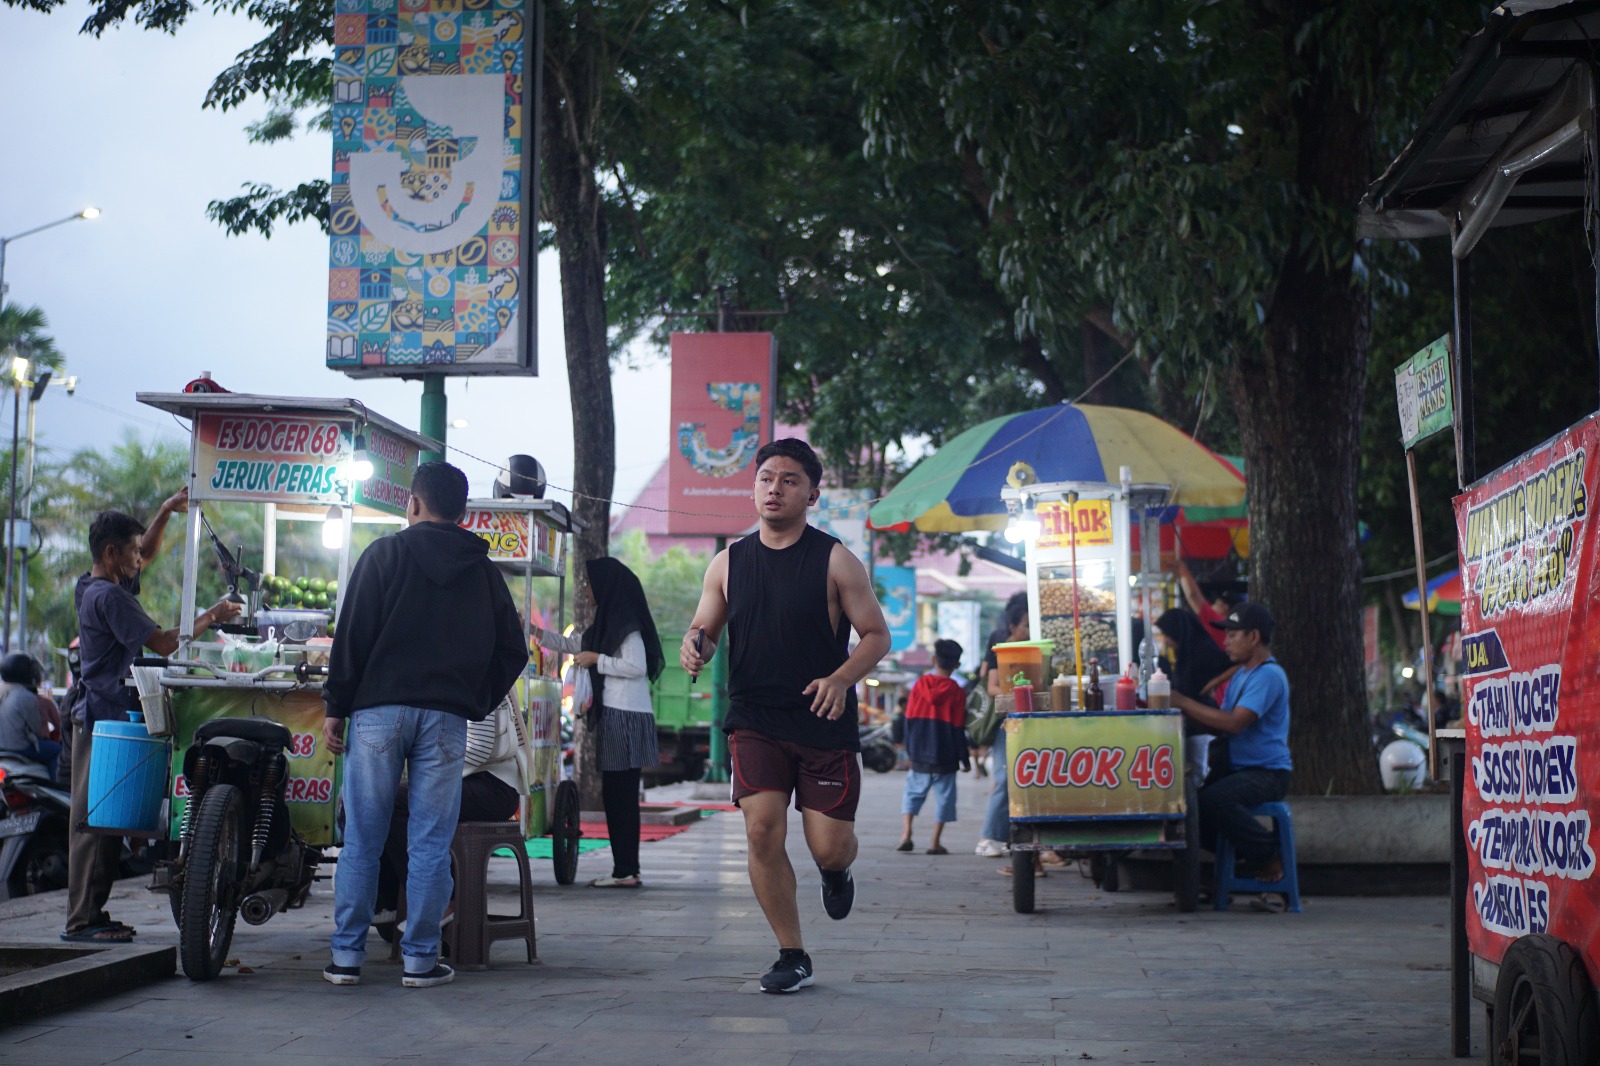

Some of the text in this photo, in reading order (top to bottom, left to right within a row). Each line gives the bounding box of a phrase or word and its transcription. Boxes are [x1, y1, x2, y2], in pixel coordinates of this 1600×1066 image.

[1417, 357, 1446, 394] ES TEH
[1420, 384, 1446, 418] MANIS
[217, 420, 339, 455] ES DOGER 68
[211, 460, 337, 494] JERUK PERAS
[393, 484, 412, 510] PERA
[458, 511, 493, 530] UR
[1467, 484, 1526, 562] WARUNG
[476, 532, 519, 552] NG
[1476, 673, 1559, 731] TAHU KOCEK
[1015, 746, 1174, 788] CILOK 46
[1482, 744, 1576, 797] SOSIS KOCEK
[284, 778, 331, 802] ERAS
[1482, 816, 1592, 870] TEMPURA KOCEK
[1526, 887, 1548, 934] ES
